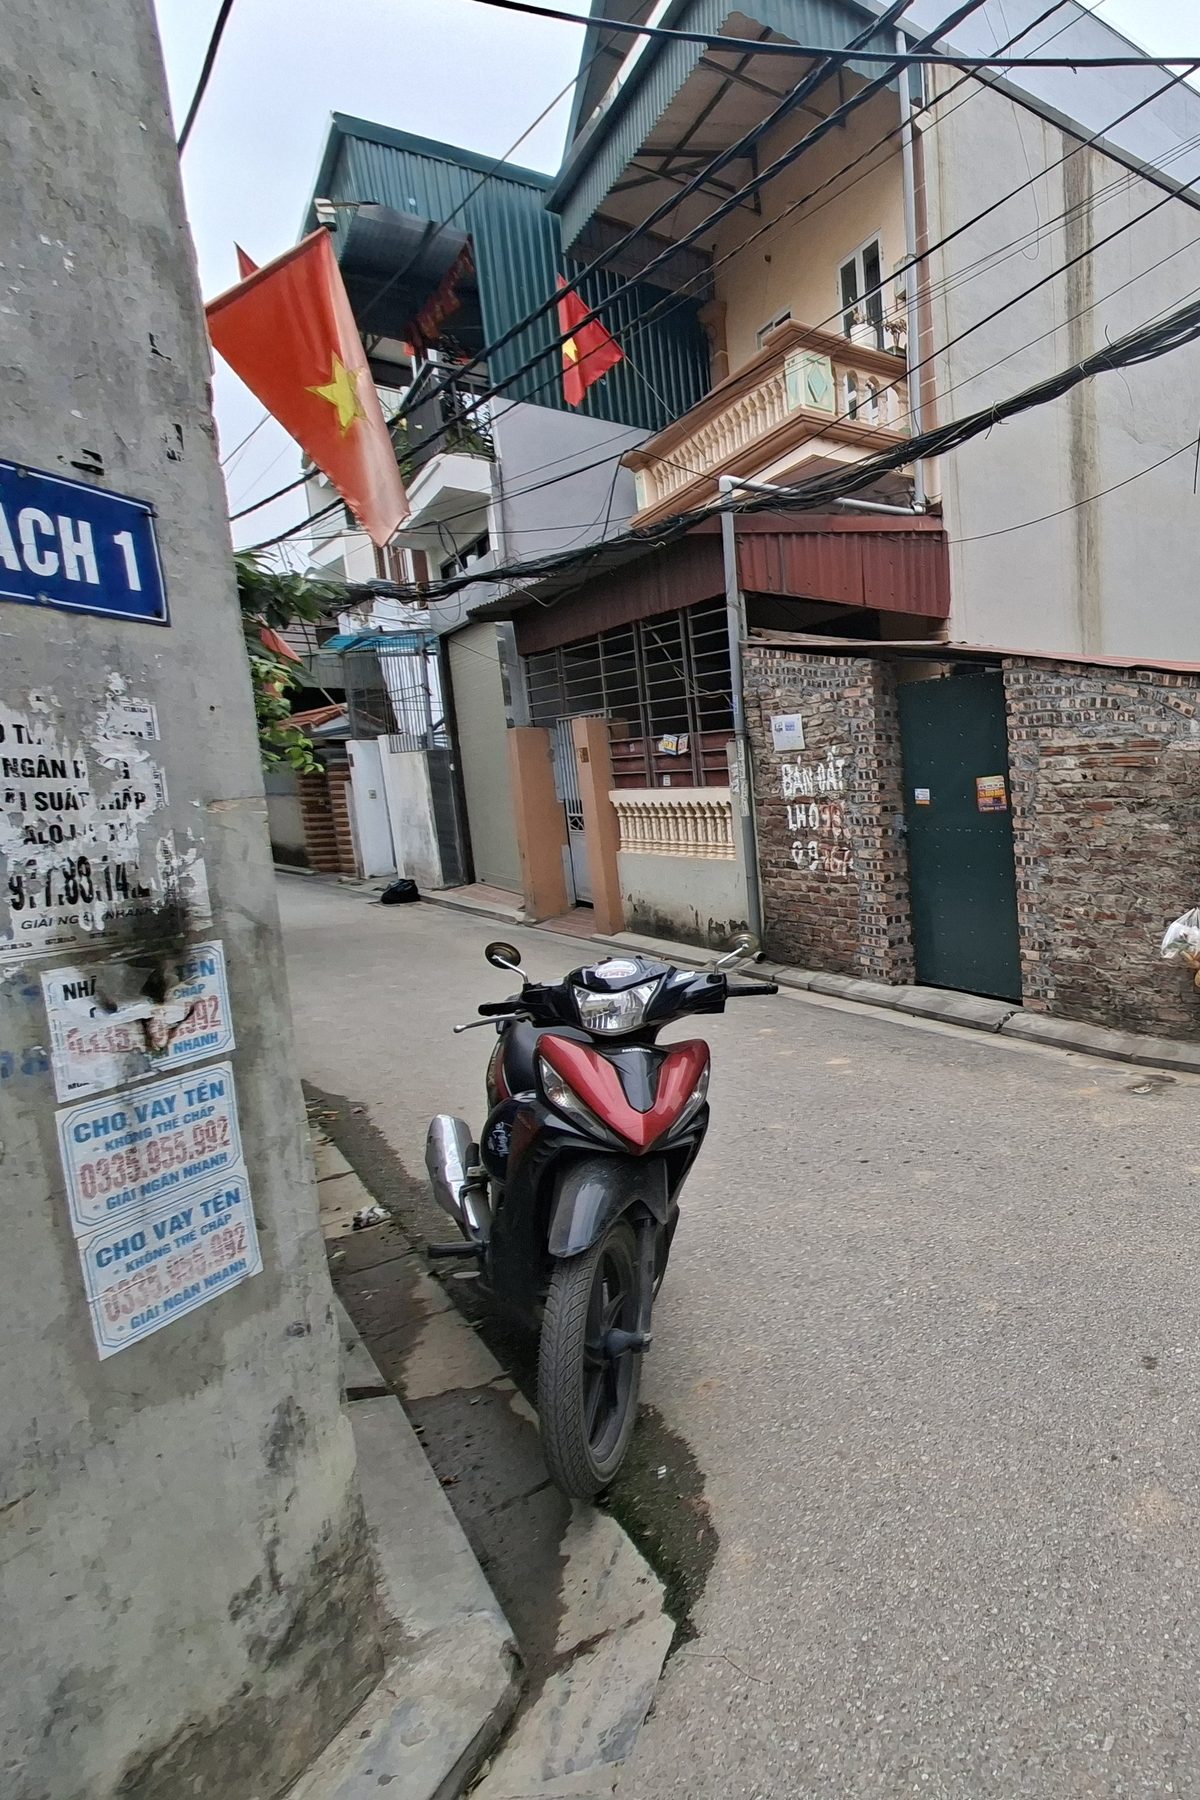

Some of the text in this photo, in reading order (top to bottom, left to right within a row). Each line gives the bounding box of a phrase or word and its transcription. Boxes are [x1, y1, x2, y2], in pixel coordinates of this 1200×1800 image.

[113, 530, 142, 592] 1
[173, 1032, 219, 1055] NHANH
[73, 1111, 127, 1144] CHO
[134, 1095, 177, 1124] VAY
[183, 1152, 228, 1179] NHANH
[95, 1230, 146, 1268] CHO
[152, 1207, 194, 1241] VAY
[203, 1258, 247, 1289] NHANH
